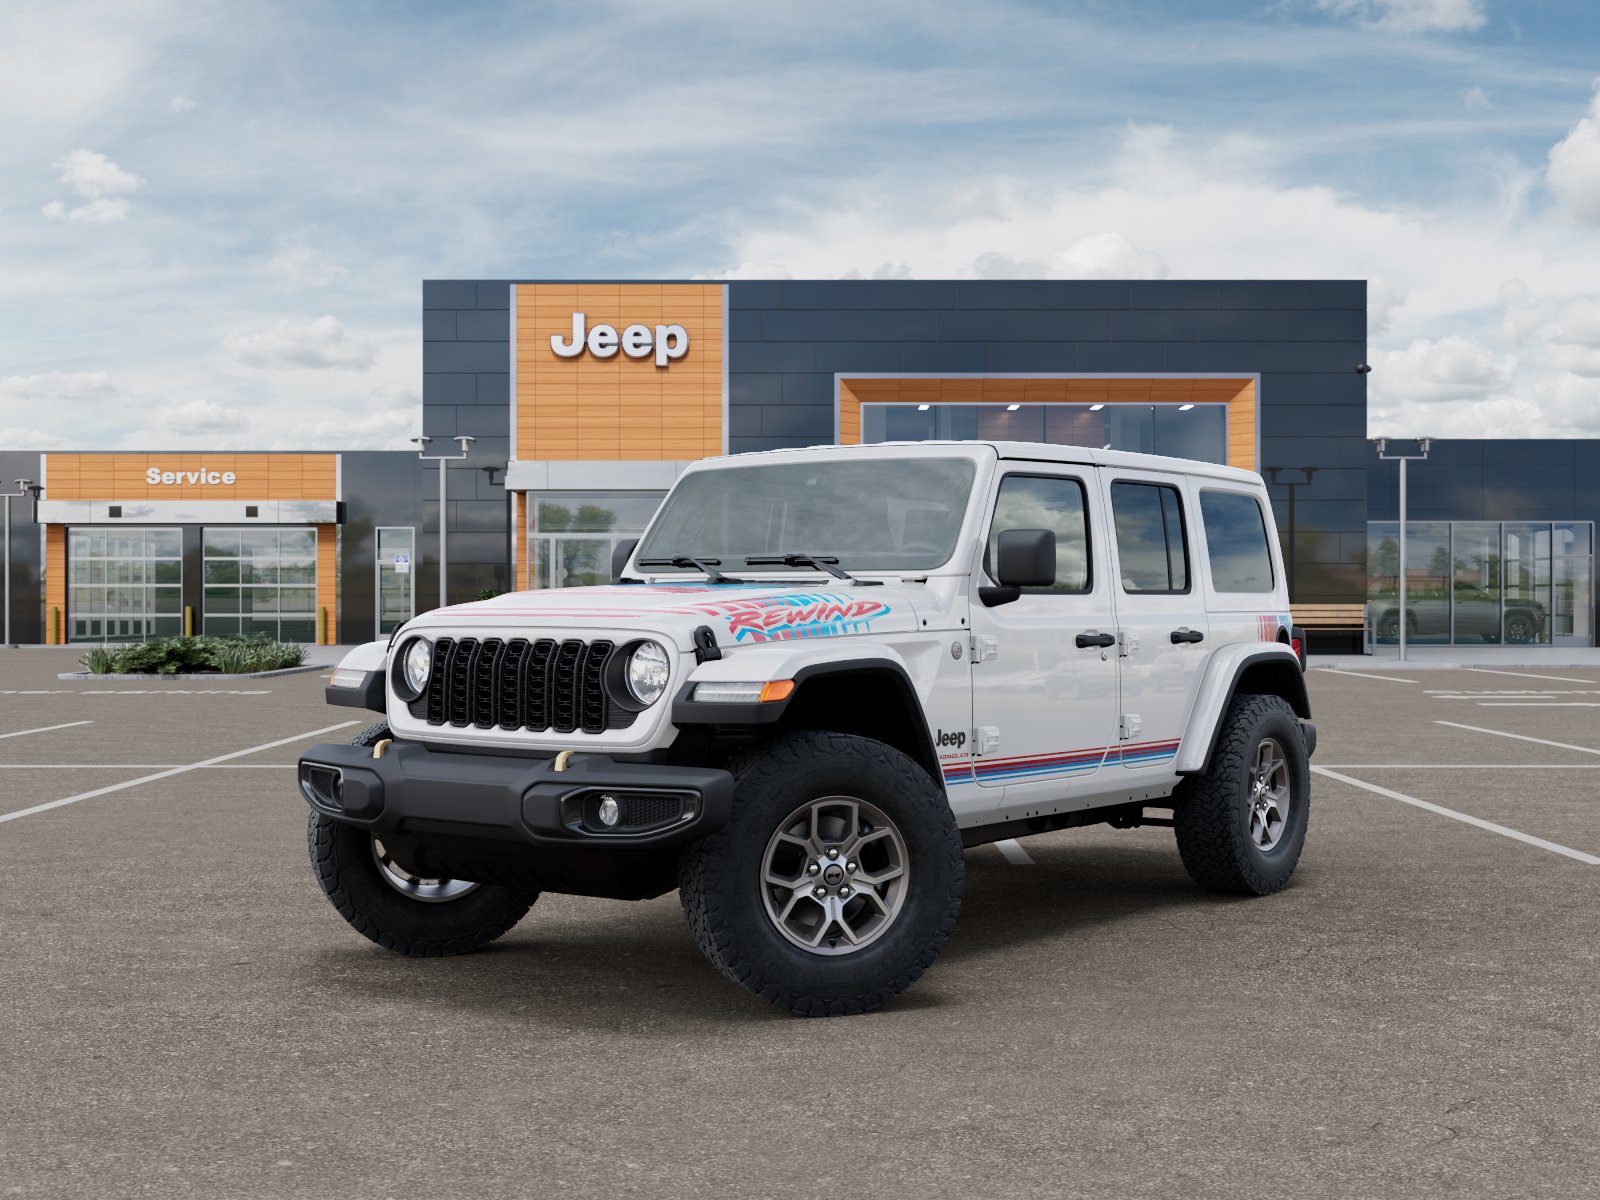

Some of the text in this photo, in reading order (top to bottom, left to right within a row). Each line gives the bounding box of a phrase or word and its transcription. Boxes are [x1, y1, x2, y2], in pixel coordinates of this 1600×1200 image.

[550, 312, 689, 367] Jeep
[146, 467, 236, 485] Service
[729, 601, 883, 634] REWIND
[935, 729, 966, 749] Jeep
